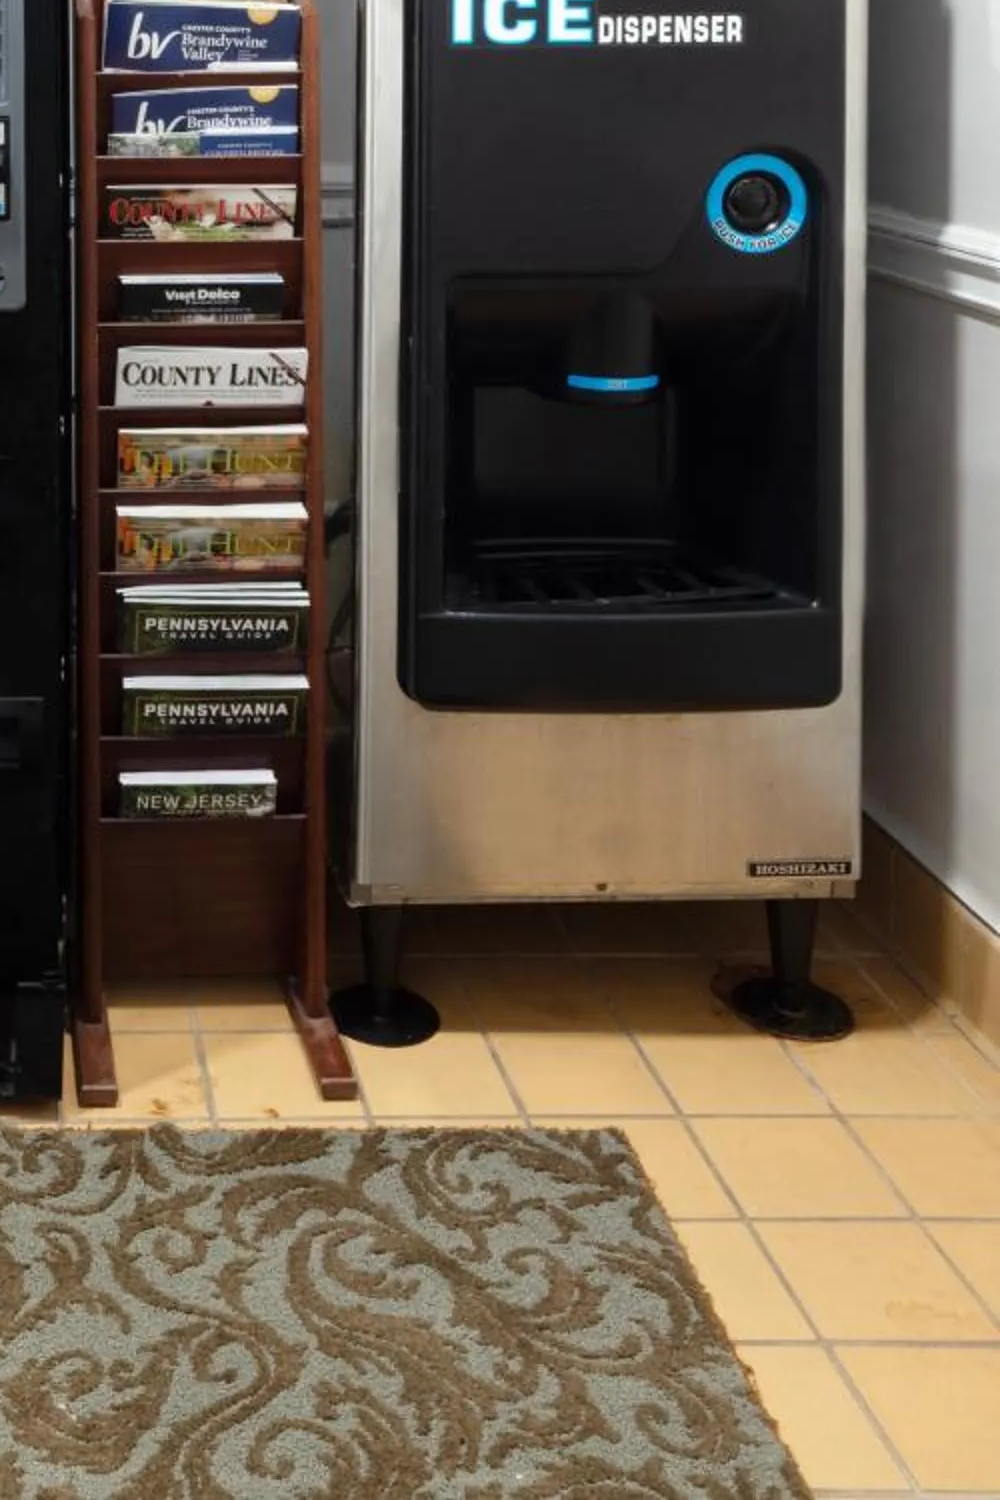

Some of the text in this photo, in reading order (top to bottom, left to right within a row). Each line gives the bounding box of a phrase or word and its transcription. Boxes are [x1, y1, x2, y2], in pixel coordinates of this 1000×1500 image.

[127, 11, 182, 60] bv
[598, 14, 743, 43] DISPENSER
[181, 32, 268, 51] Brandywine
[181, 47, 225, 62] Valley
[186, 112, 273, 130] Brandywine
[165, 287, 241, 301] Visit Delco
[122, 362, 301, 387] COUNTY LINES
[144, 616, 290, 632] PENNSYLVANIA
[161, 631, 273, 640] TRAVEL GUIDE
[143, 702, 289, 718] PENNSYLVANIA
[161, 716, 272, 726] TRAVEL GUIDE
[137, 793, 264, 810] NEW JERSEY
[755, 863, 848, 875] HOSHIZAKI
